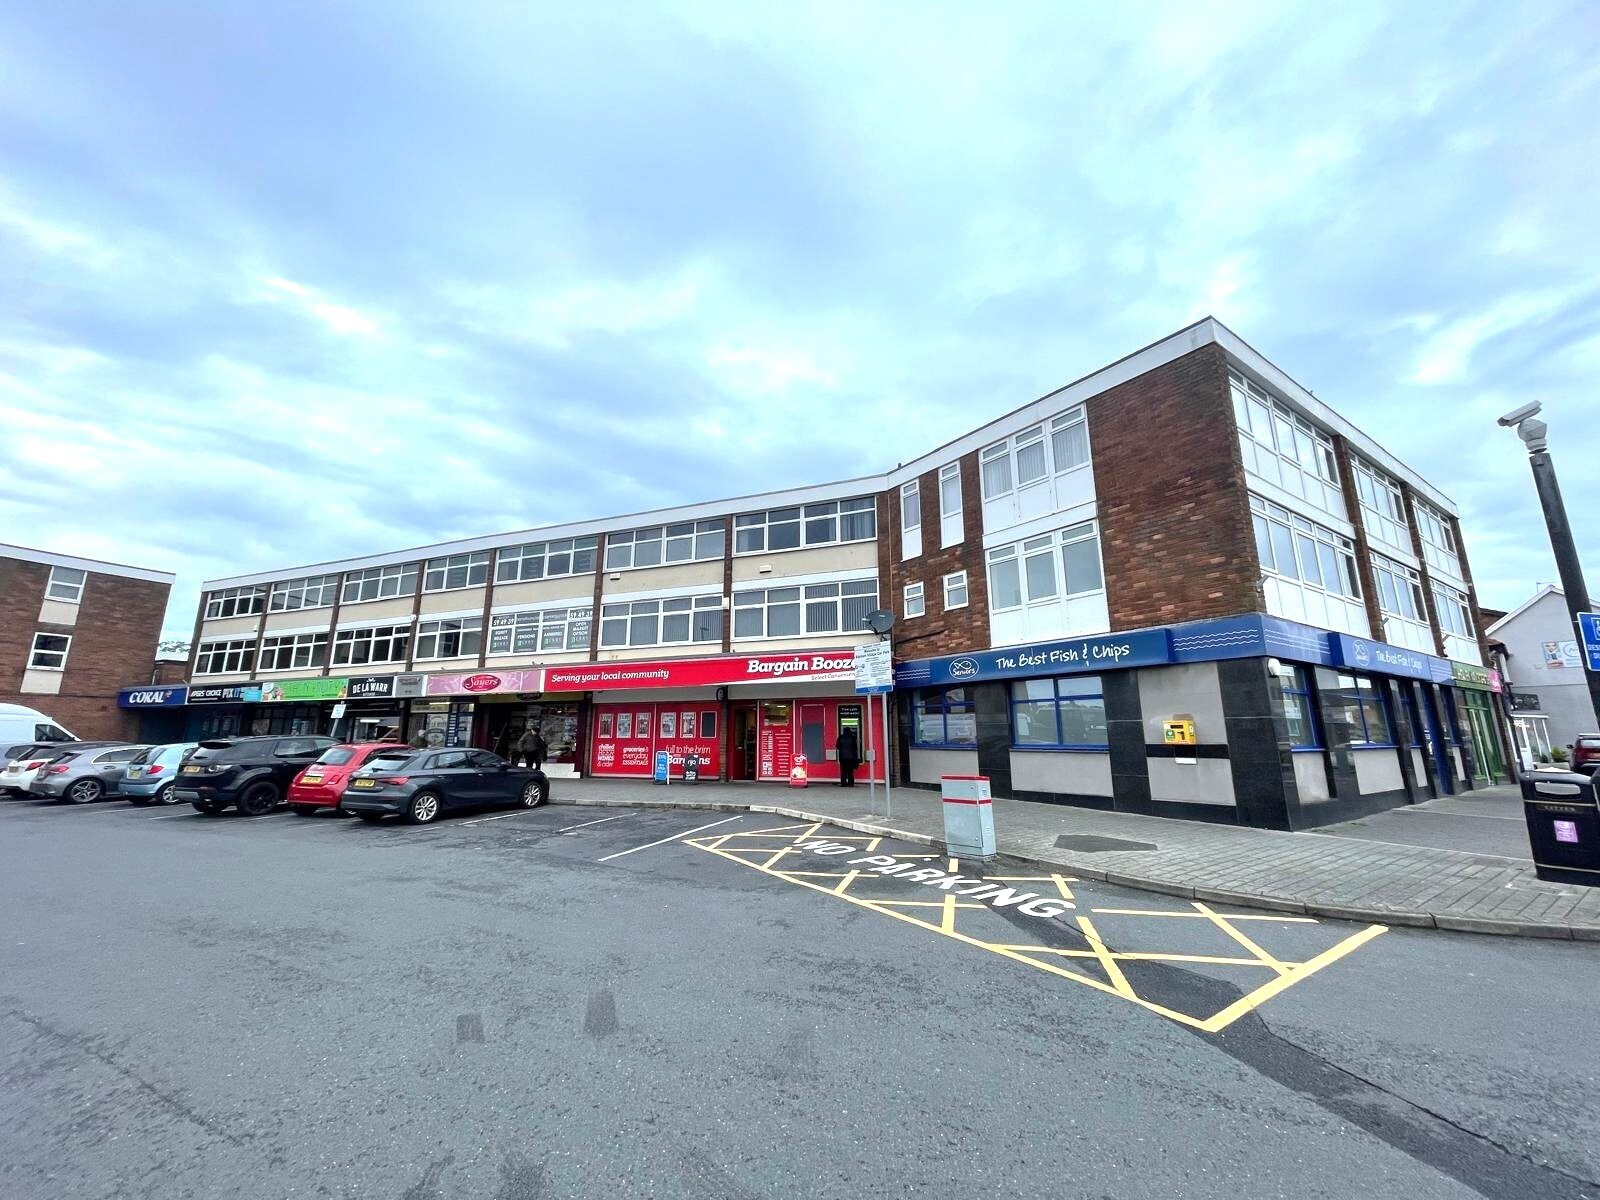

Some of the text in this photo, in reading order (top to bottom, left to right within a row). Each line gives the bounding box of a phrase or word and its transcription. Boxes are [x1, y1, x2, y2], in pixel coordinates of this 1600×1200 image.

[996, 643, 1130, 669] The Best Fish & Chips
[747, 657, 808, 675] Bargain
[952, 667, 975, 676] Seniors
[465, 676, 498, 688] Sayers
[552, 669, 669, 684] Serving your local community
[353, 683, 388, 694] DE LA WARR
[129, 691, 164, 703] CORAL
[666, 745, 711, 754] full to the brim
[668, 755, 711, 767] Barns
[792, 840, 1077, 918] NO PARKING
